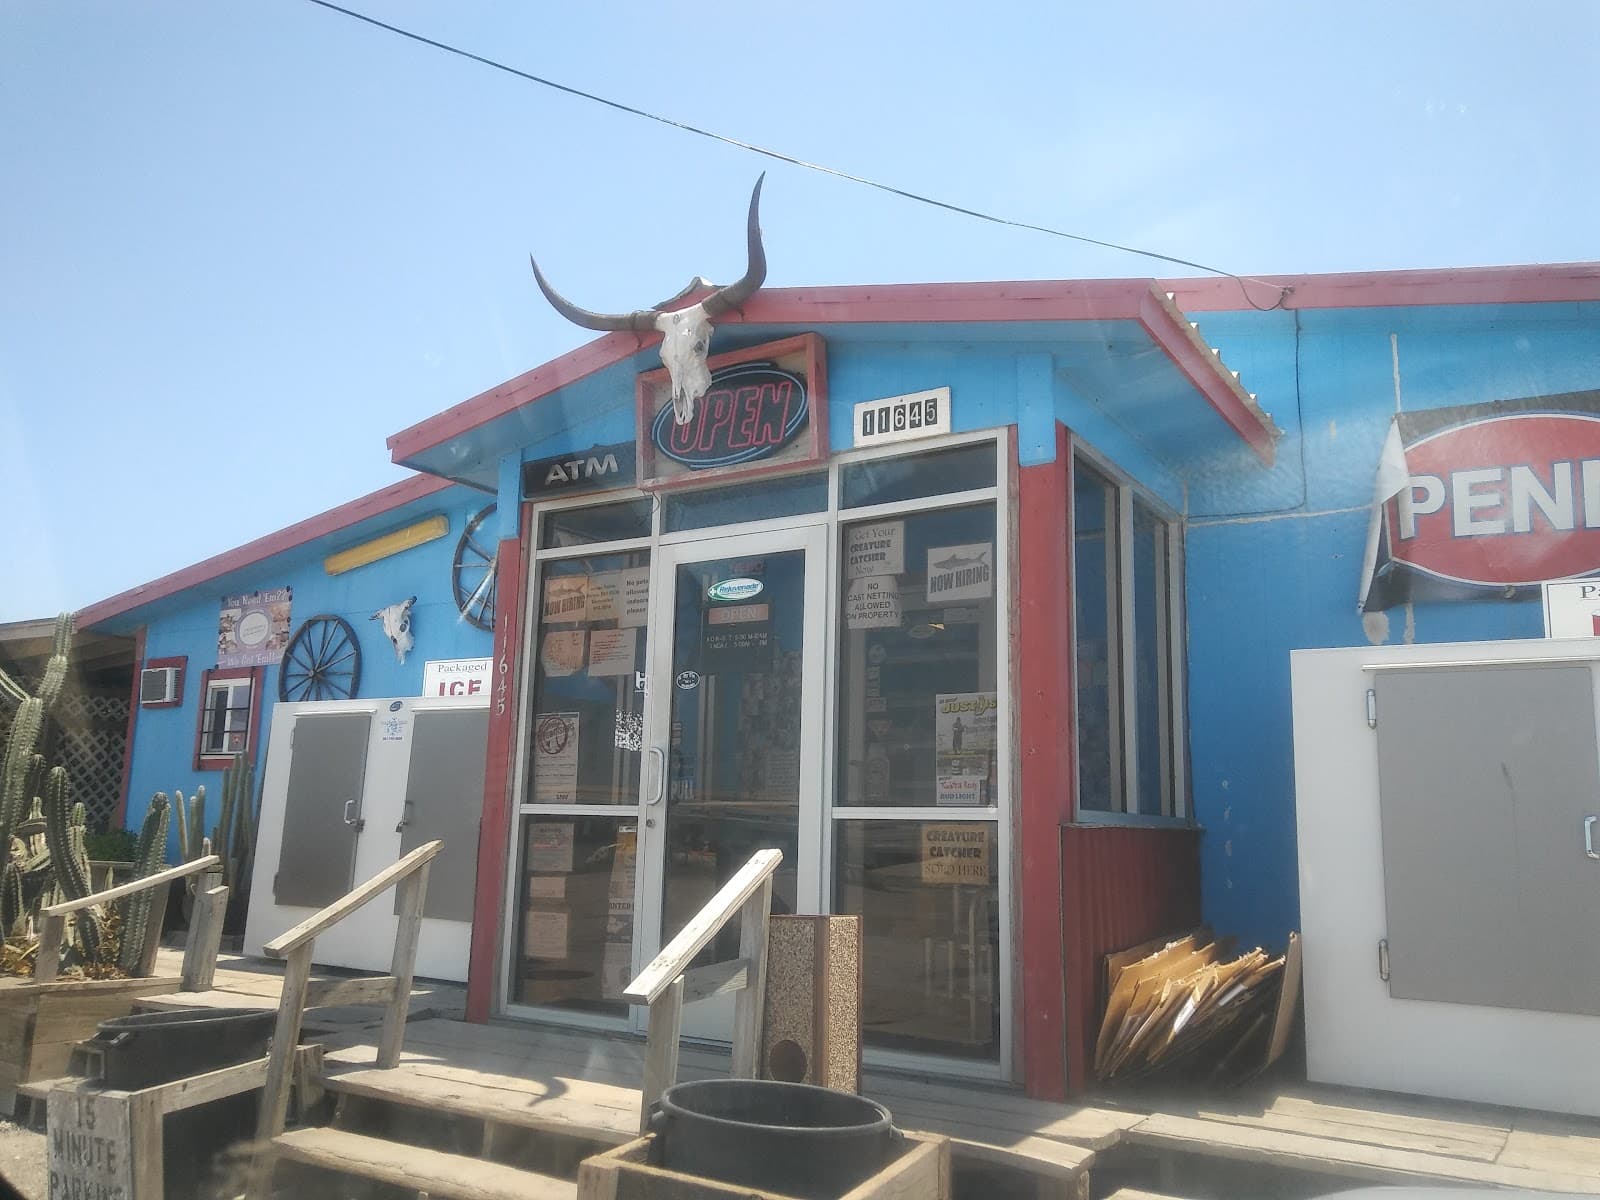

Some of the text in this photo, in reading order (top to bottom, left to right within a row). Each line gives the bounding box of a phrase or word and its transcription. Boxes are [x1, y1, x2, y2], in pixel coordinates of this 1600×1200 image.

[670, 382, 793, 453] OPEN
[862, 398, 938, 437] 11645
[544, 454, 619, 485] ATM
[872, 527, 896, 538] Your
[850, 539, 892, 553] CREATURE
[850, 552, 887, 565] CATCHER
[930, 564, 990, 594] NOW HIRING
[867, 583, 879, 591] NO
[848, 591, 900, 602] CAST NETTING
[544, 600, 562, 617] NOW
[855, 601, 891, 611] ALLOWED
[720, 607, 757, 621] OPEN
[858, 610, 899, 620] PROPERTY
[438, 662, 488, 673] Packaged
[495, 611, 508, 718] 11645
[439, 678, 482, 697] ICE
[926, 831, 985, 843] CREATURE
[929, 847, 982, 859] CATCHER
[925, 863, 987, 877] SOLD HERE
[77, 1097, 96, 1130] 15
[53, 1128, 117, 1176] MINUTE
